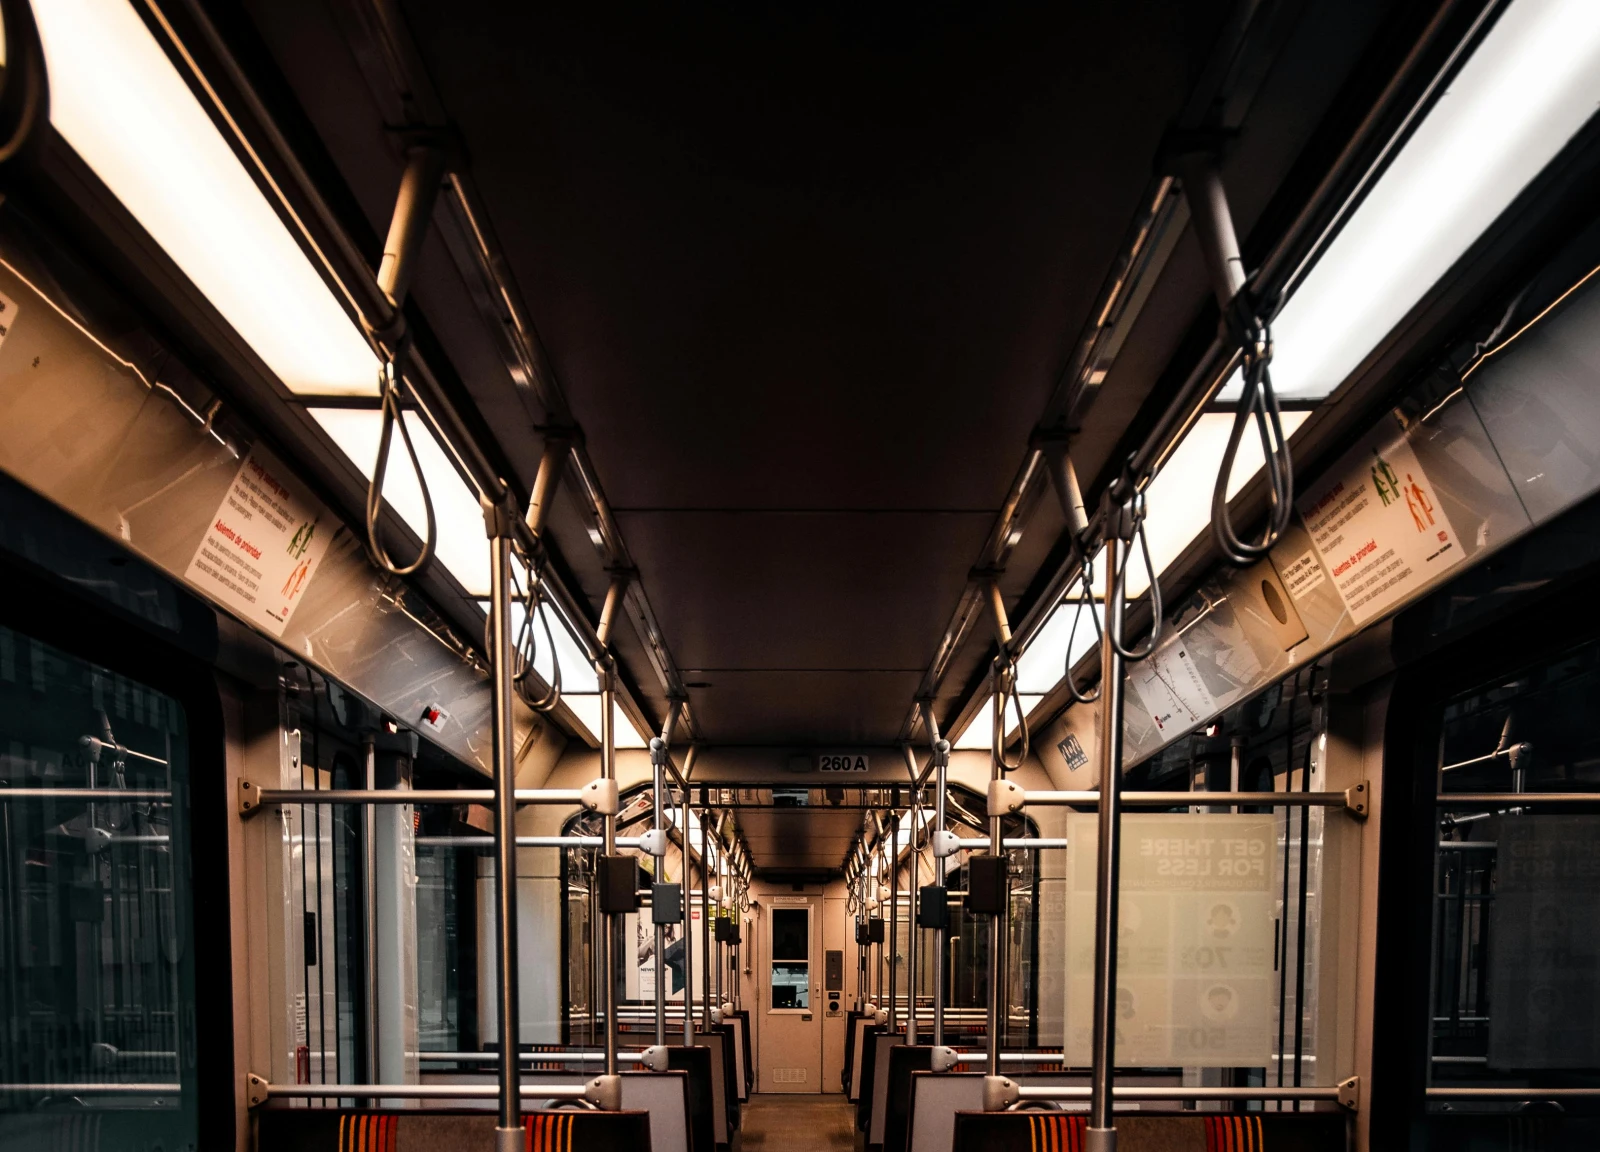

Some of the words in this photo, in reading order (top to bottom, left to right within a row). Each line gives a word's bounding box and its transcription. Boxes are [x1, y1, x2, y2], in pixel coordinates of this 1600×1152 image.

[214, 519, 235, 541] Asientos
[234, 535, 242, 546] de
[239, 540, 261, 560] prioridad
[1332, 560, 1351, 576] Asientos
[1349, 555, 1357, 564] de
[1355, 539, 1377, 561] prioridad
[821, 756, 852, 770] 260
[853, 756, 866, 770] A
